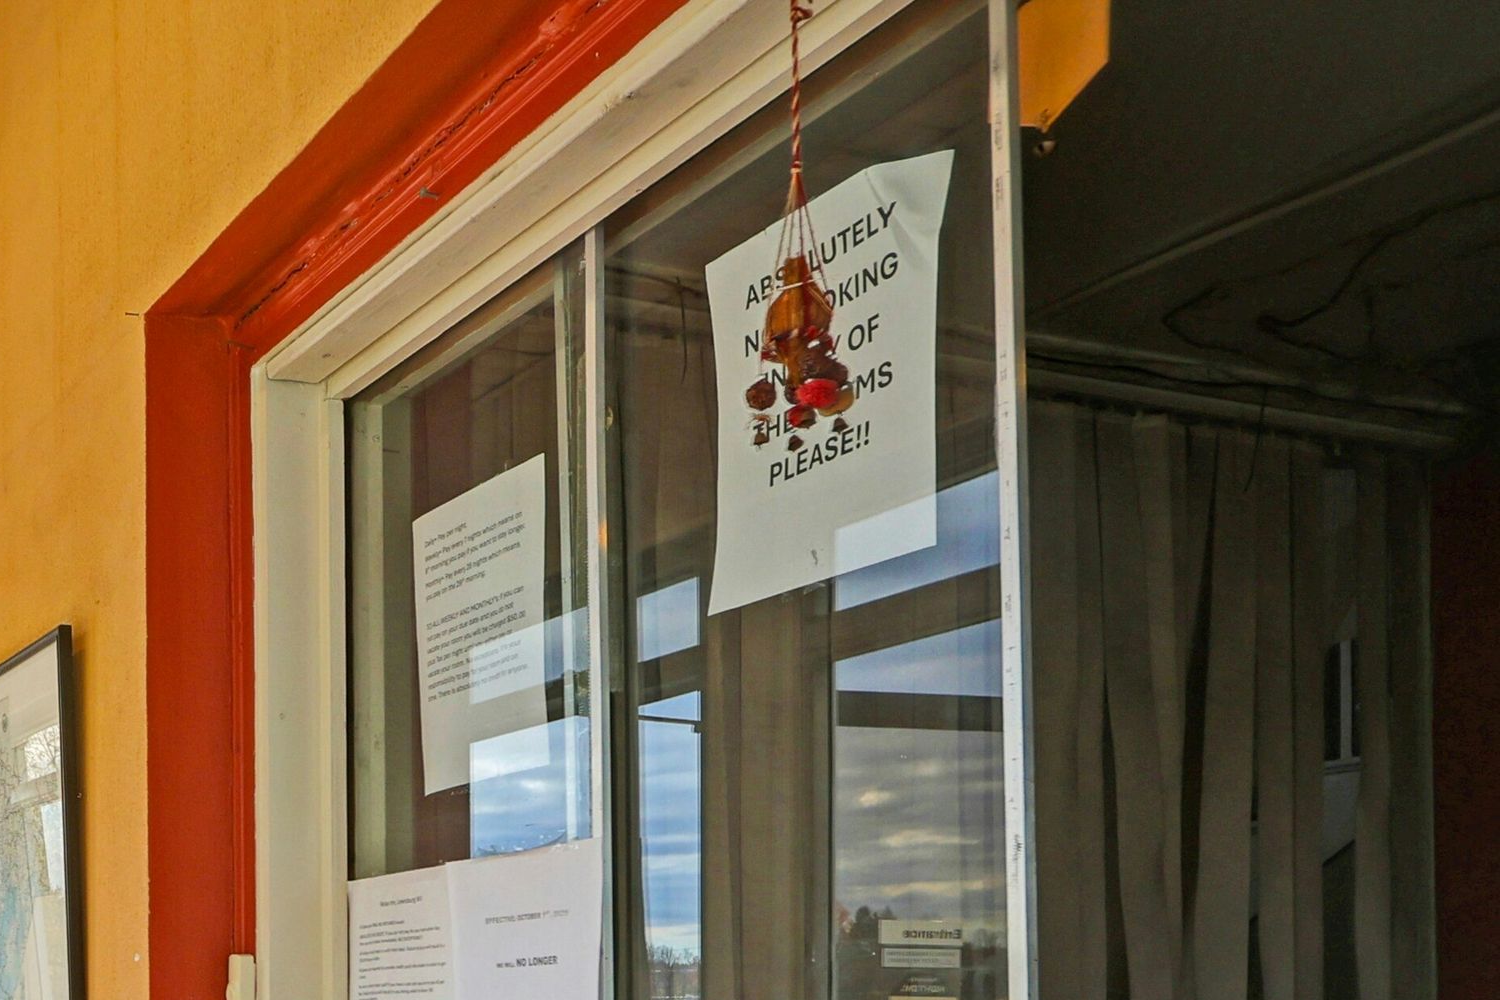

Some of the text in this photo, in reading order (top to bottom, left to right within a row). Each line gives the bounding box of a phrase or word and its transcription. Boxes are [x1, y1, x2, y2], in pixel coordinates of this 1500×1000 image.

[745, 201, 897, 310] ABSLUTELY
[847, 313, 880, 351] OF
[769, 421, 871, 487] PLEASE!!
[516, 957, 526, 967] NO
[528, 954, 558, 966] LONGER
